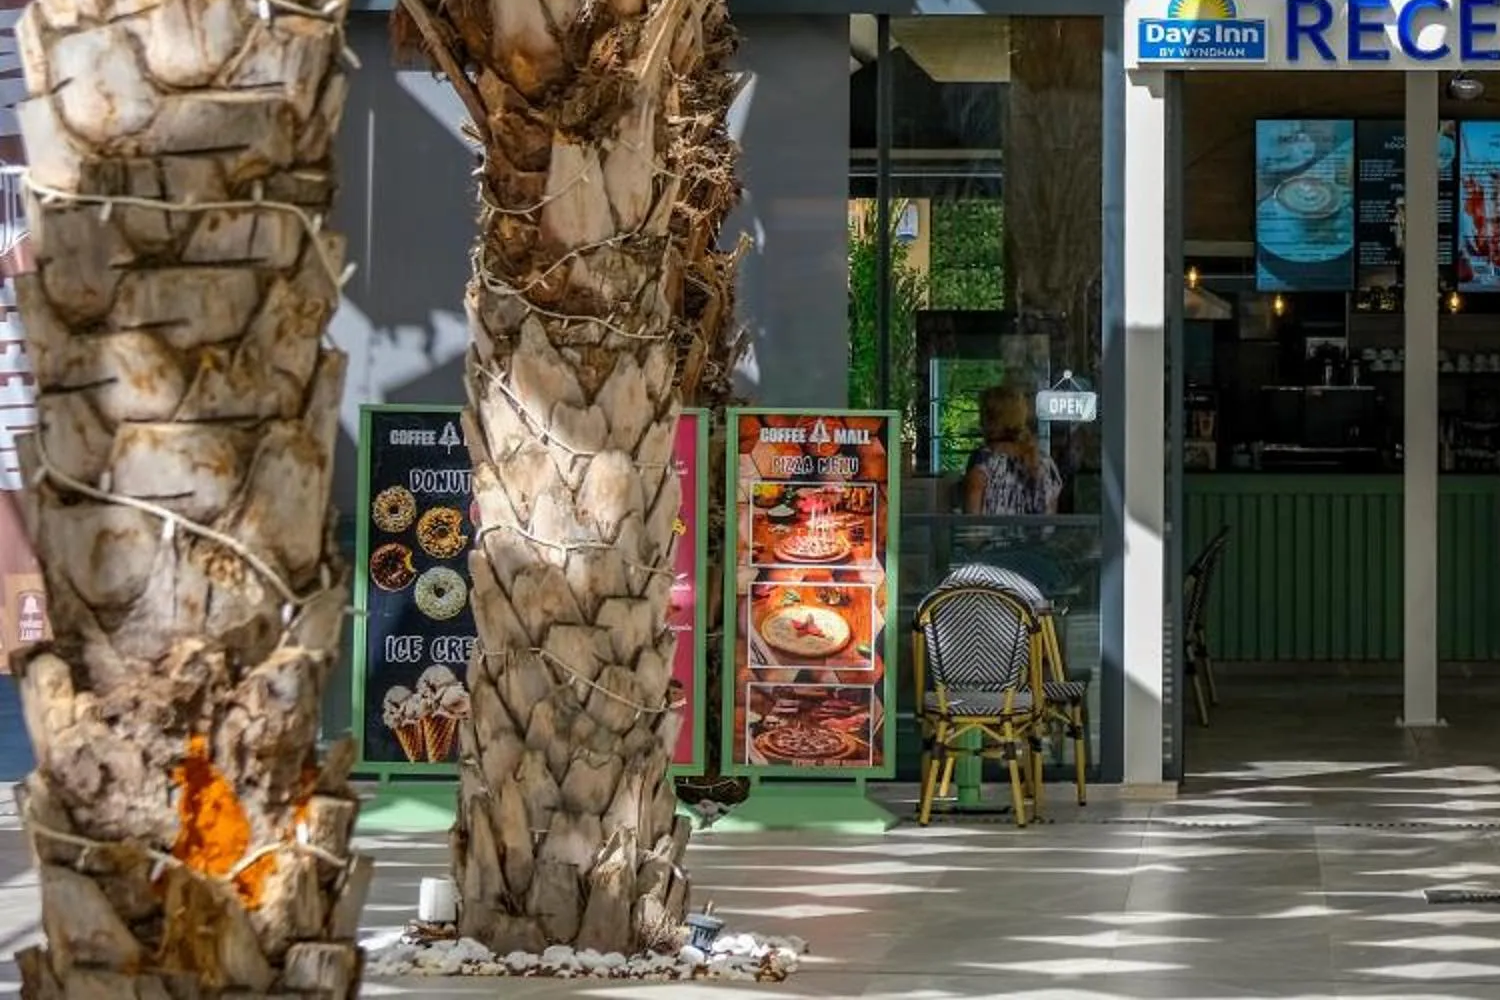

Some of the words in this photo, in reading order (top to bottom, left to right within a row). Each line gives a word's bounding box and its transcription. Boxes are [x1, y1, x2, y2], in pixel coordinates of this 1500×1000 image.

[1146, 24, 1211, 45] Days
[1215, 24, 1259, 43] Inn
[1159, 48, 1174, 57] BY
[1179, 48, 1245, 57] WYNDHAM
[1050, 398, 1084, 414] OPEN
[389, 429, 436, 446] COFFEE
[760, 427, 806, 443] COFFEE
[833, 429, 871, 445] MALL
[385, 635, 424, 663] ICE
[430, 636, 475, 663] CRE
